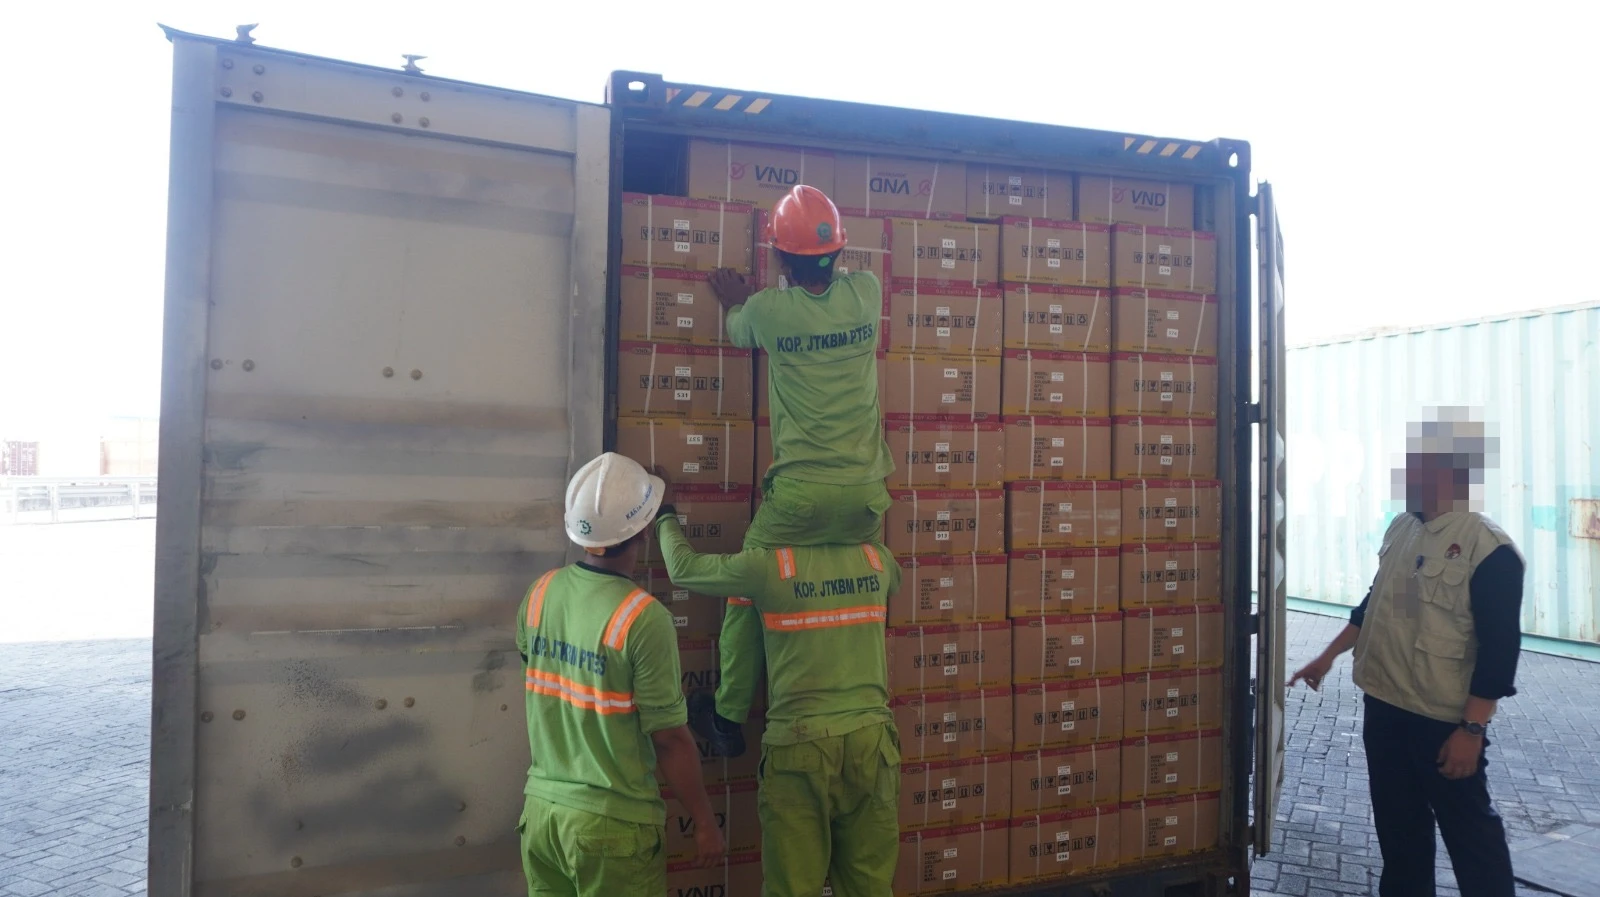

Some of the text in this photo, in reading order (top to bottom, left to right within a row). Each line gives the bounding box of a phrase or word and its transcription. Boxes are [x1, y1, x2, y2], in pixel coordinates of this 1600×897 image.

[755, 165, 798, 185] VND
[869, 177, 909, 194] VND
[1131, 189, 1166, 206] VND
[776, 322, 873, 352] KOP. JTKBM PTES
[794, 573, 880, 599] KOP. JTKBM PTES
